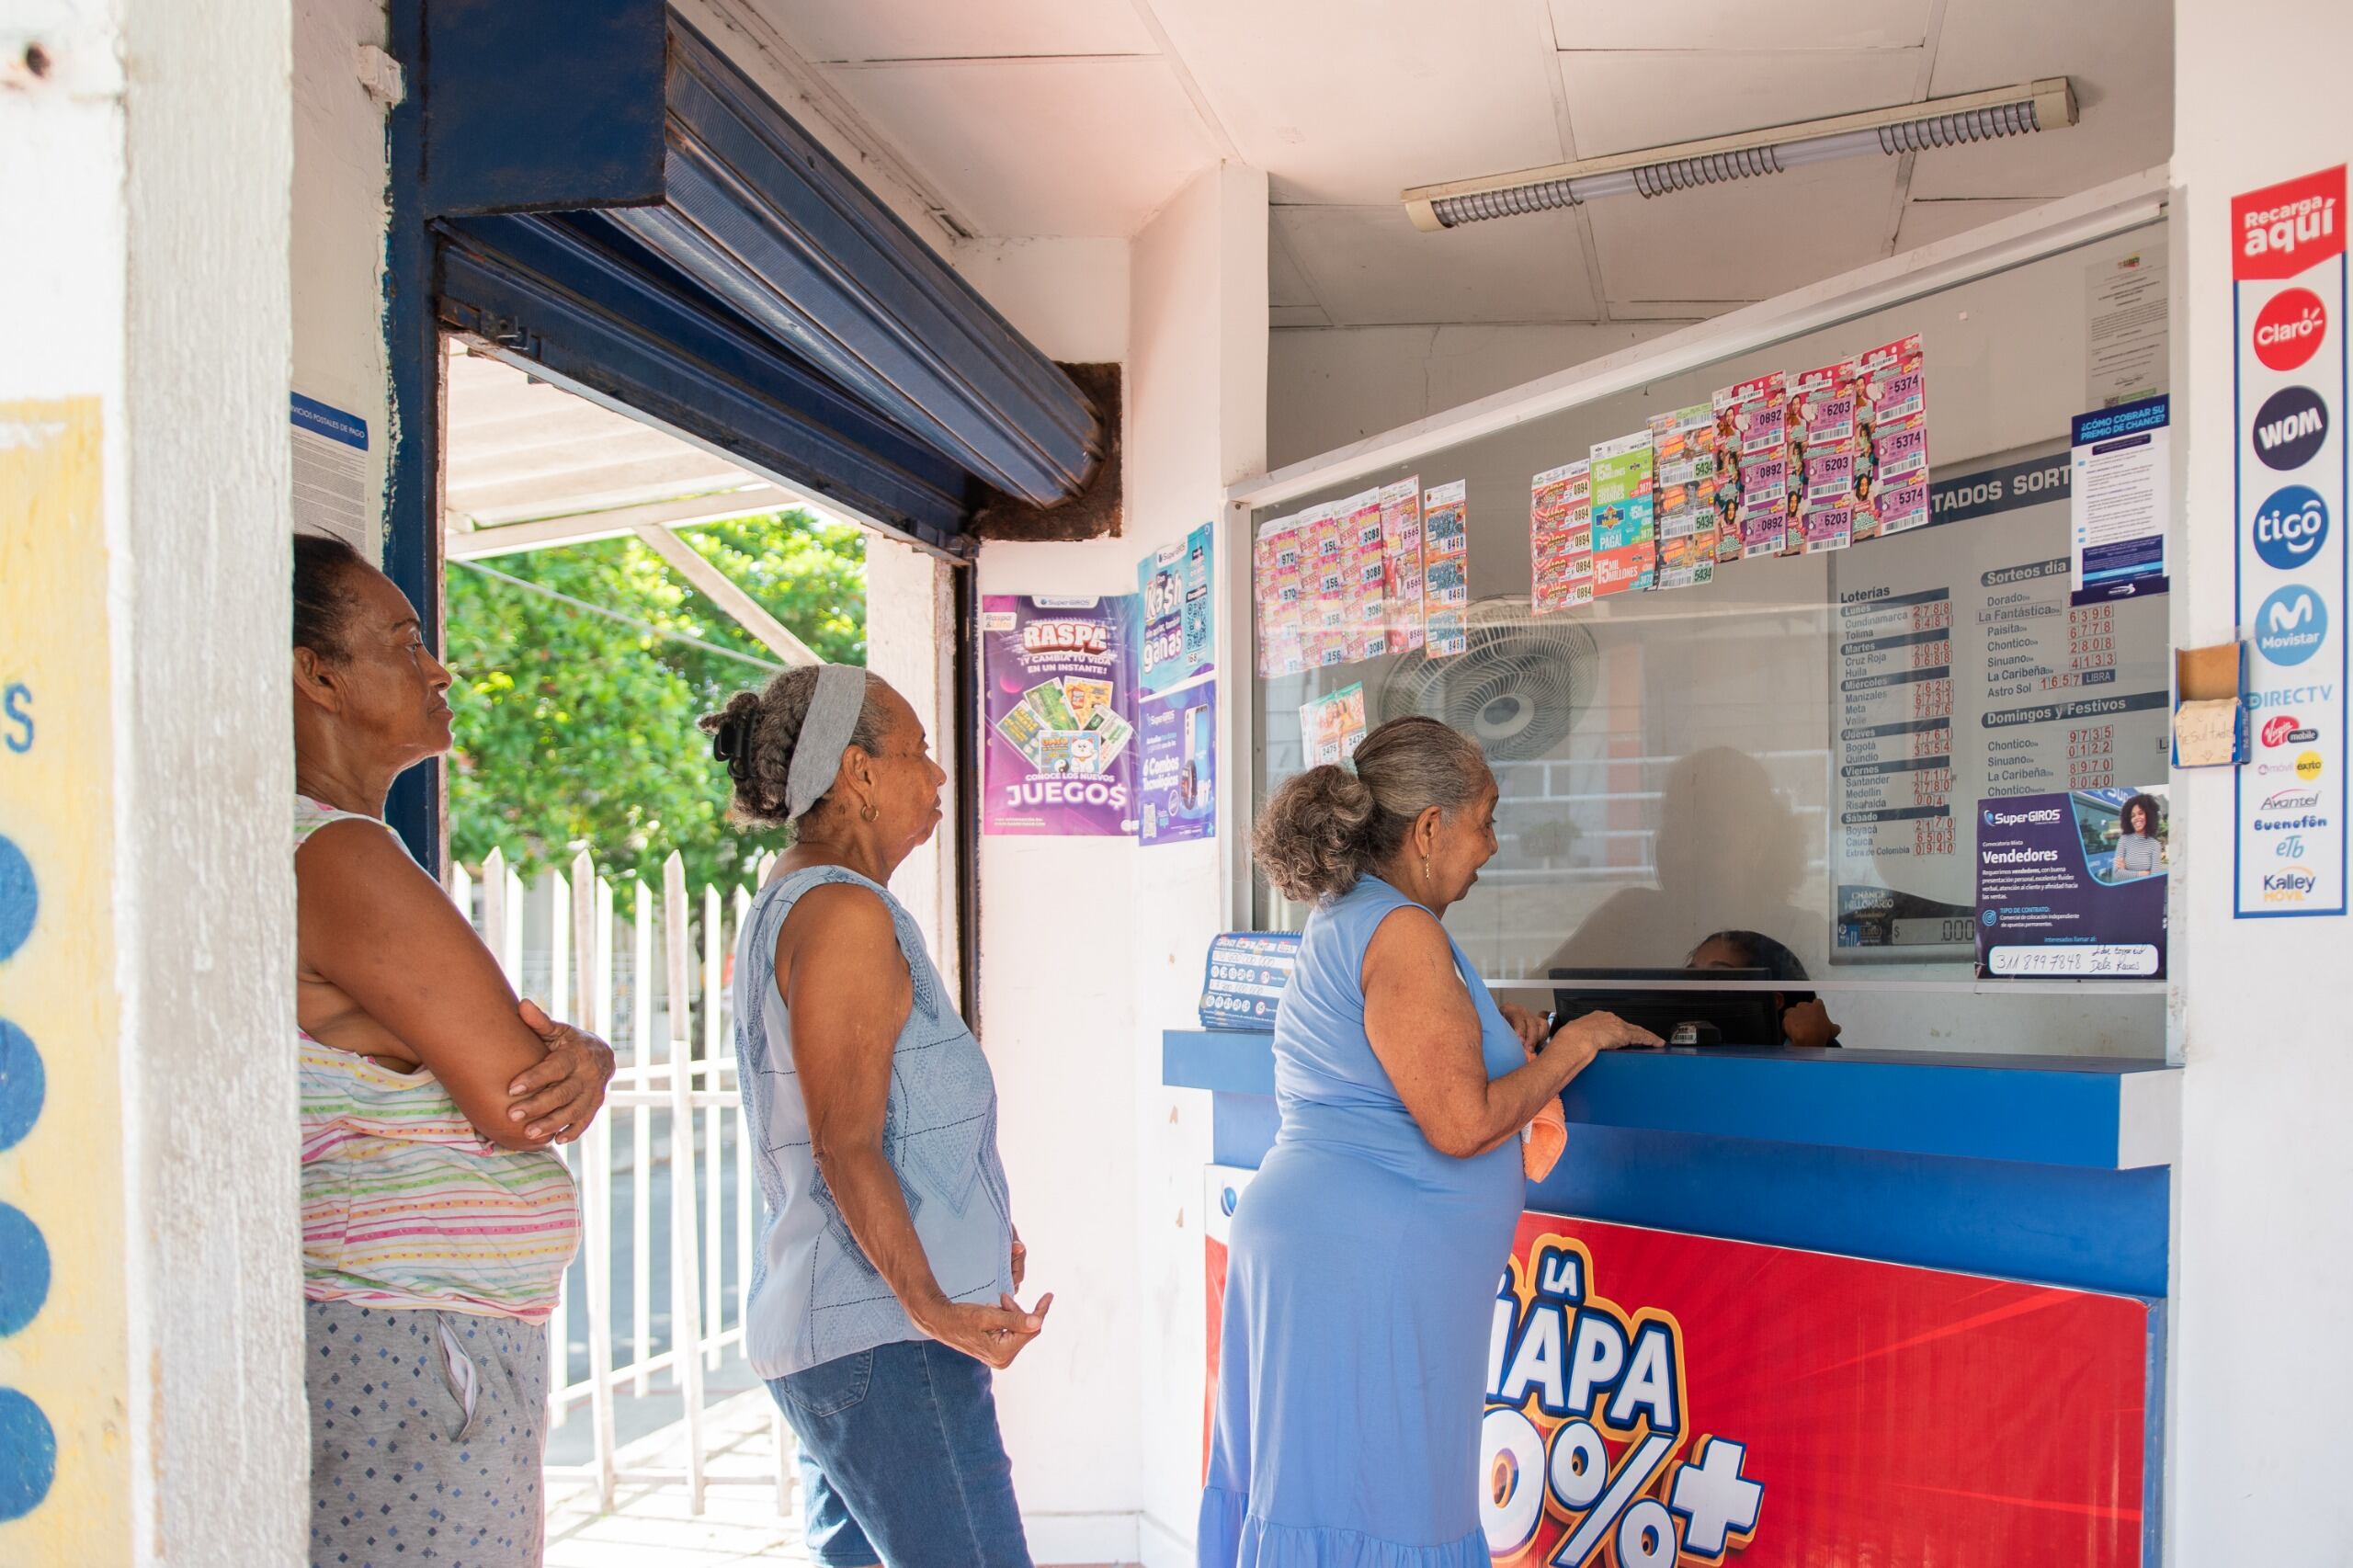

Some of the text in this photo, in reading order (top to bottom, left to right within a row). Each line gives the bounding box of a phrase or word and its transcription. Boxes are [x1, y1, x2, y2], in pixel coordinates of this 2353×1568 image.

[2245, 195, 2323, 228] Recarga
[2244, 198, 2336, 256] aquí
[2257, 315, 2315, 346] Claro
[1894, 375, 1919, 392] 5374
[1827, 402, 1850, 415] 6203
[2114, 408, 2151, 424] COBRAR
[2152, 404, 2165, 415] SU
[1759, 410, 1782, 425] 0892
[2081, 414, 2165, 440] PREMIO DE CHANCE?
[2258, 407, 2323, 449] WOM
[1896, 432, 1921, 449] 5374
[1760, 463, 1782, 478] 0892
[1824, 457, 1848, 471] 6203
[1899, 488, 1924, 505] 5374
[1930, 481, 2003, 514] TADOS
[1824, 513, 1847, 526] 6203
[2258, 508, 2322, 542] tigo
[1987, 559, 2067, 585] Sorteos día
[1840, 585, 1891, 603] Loterías
[1987, 593, 2023, 607] Dorado
[1913, 602, 1950, 617] 2788
[1979, 605, 2111, 624] La Fantástica 6396
[1846, 610, 1950, 630] Cundinamarca 6481
[1023, 623, 1108, 650] RASPA
[1846, 628, 1874, 641] Tolima
[1987, 620, 2111, 639] Paisita 6778
[1845, 641, 1949, 656] Martes 2096
[1987, 638, 2112, 653] Chontico 2808
[2262, 632, 2320, 650] Movistar
[1032, 654, 1070, 663] CAMBIA
[1074, 654, 1086, 663] TU
[1087, 655, 1112, 665] VIDA
[1846, 652, 1949, 667] Cruz Roja 0688
[1987, 653, 2114, 669] Sinuano 4133
[1028, 664, 1108, 675] EN UN INSTANTE!
[1846, 668, 1867, 678] Huila
[1987, 665, 2047, 682] La Caribeña
[1915, 681, 1951, 696] 7623
[1987, 673, 2111, 699] Astro Sol 1657 LIBRA
[1846, 690, 1951, 706] Manizales 6731
[1846, 703, 1951, 717] Meta 7876
[1987, 699, 2126, 725] Domingos y Festivos
[1846, 716, 1867, 726] Valle
[1915, 729, 1950, 744] 7761
[1988, 726, 2111, 752] Chontico 9735
[2290, 730, 2316, 741] mobile
[1846, 741, 1949, 756] Bogotá 3354
[1988, 742, 2109, 767] Sinuano 0122
[1025, 772, 1062, 782] CONOCE
[1063, 772, 1077, 780] LOS
[1846, 766, 1949, 782] Viernes 1717
[1988, 759, 2110, 782] La Caribeña 8970
[1846, 775, 1949, 794] Santander 2780
[1988, 775, 2110, 797] Chontico 8040
[1846, 788, 1942, 806] Medellín 004
[1846, 798, 1887, 810] Risaralda
[2260, 791, 2320, 810] Avantel
[1846, 812, 1878, 823] Sábado
[1846, 815, 1953, 836] Boyacá 2170
[1995, 809, 2061, 825] SuperGIROS
[1847, 830, 1953, 846] Cauca 6503
[1847, 843, 1953, 858] Extra de Colombia 0940
[1983, 847, 2058, 864] Vendedores
[2264, 874, 2316, 893] Kalley
[1543, 1257, 1577, 1297] LA
